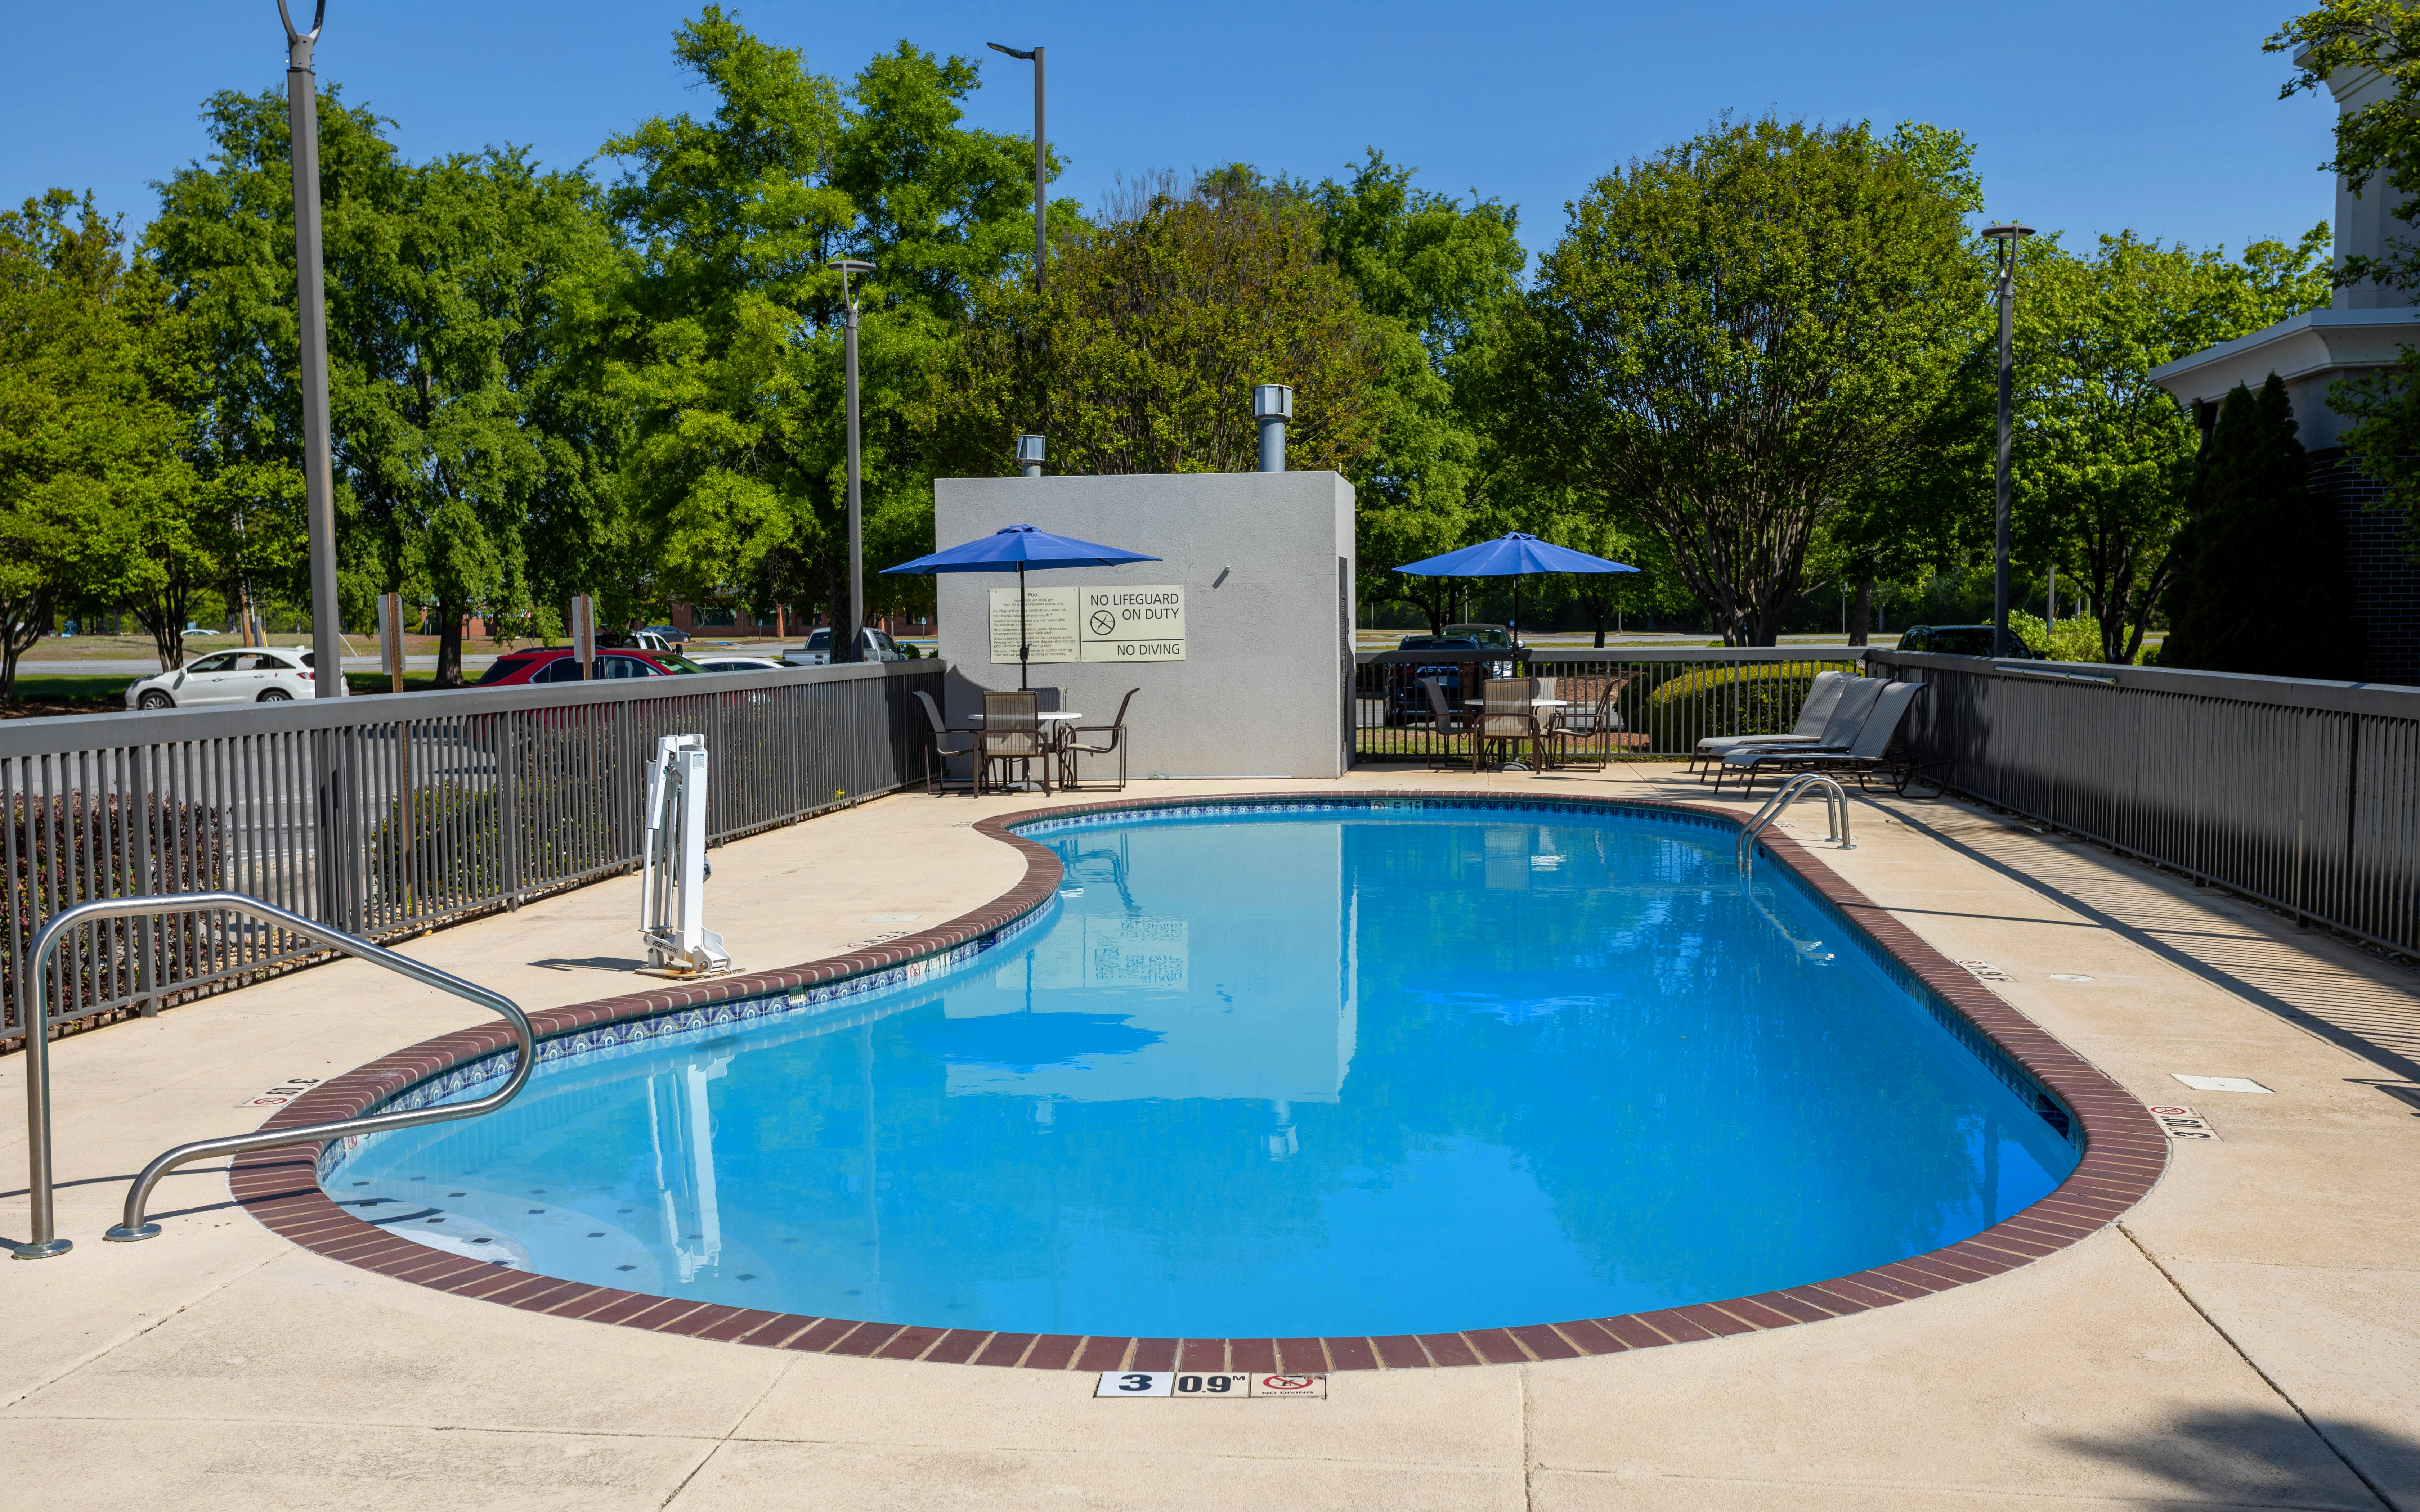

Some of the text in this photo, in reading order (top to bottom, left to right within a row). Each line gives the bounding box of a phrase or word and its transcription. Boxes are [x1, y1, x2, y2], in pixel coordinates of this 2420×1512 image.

[1091, 593, 1179, 606] NO LIFEGUARD
[1122, 608, 1179, 620] ON DUTY
[1117, 644, 1179, 655] NO DIVING
[1119, 1374, 1153, 1391] 3
